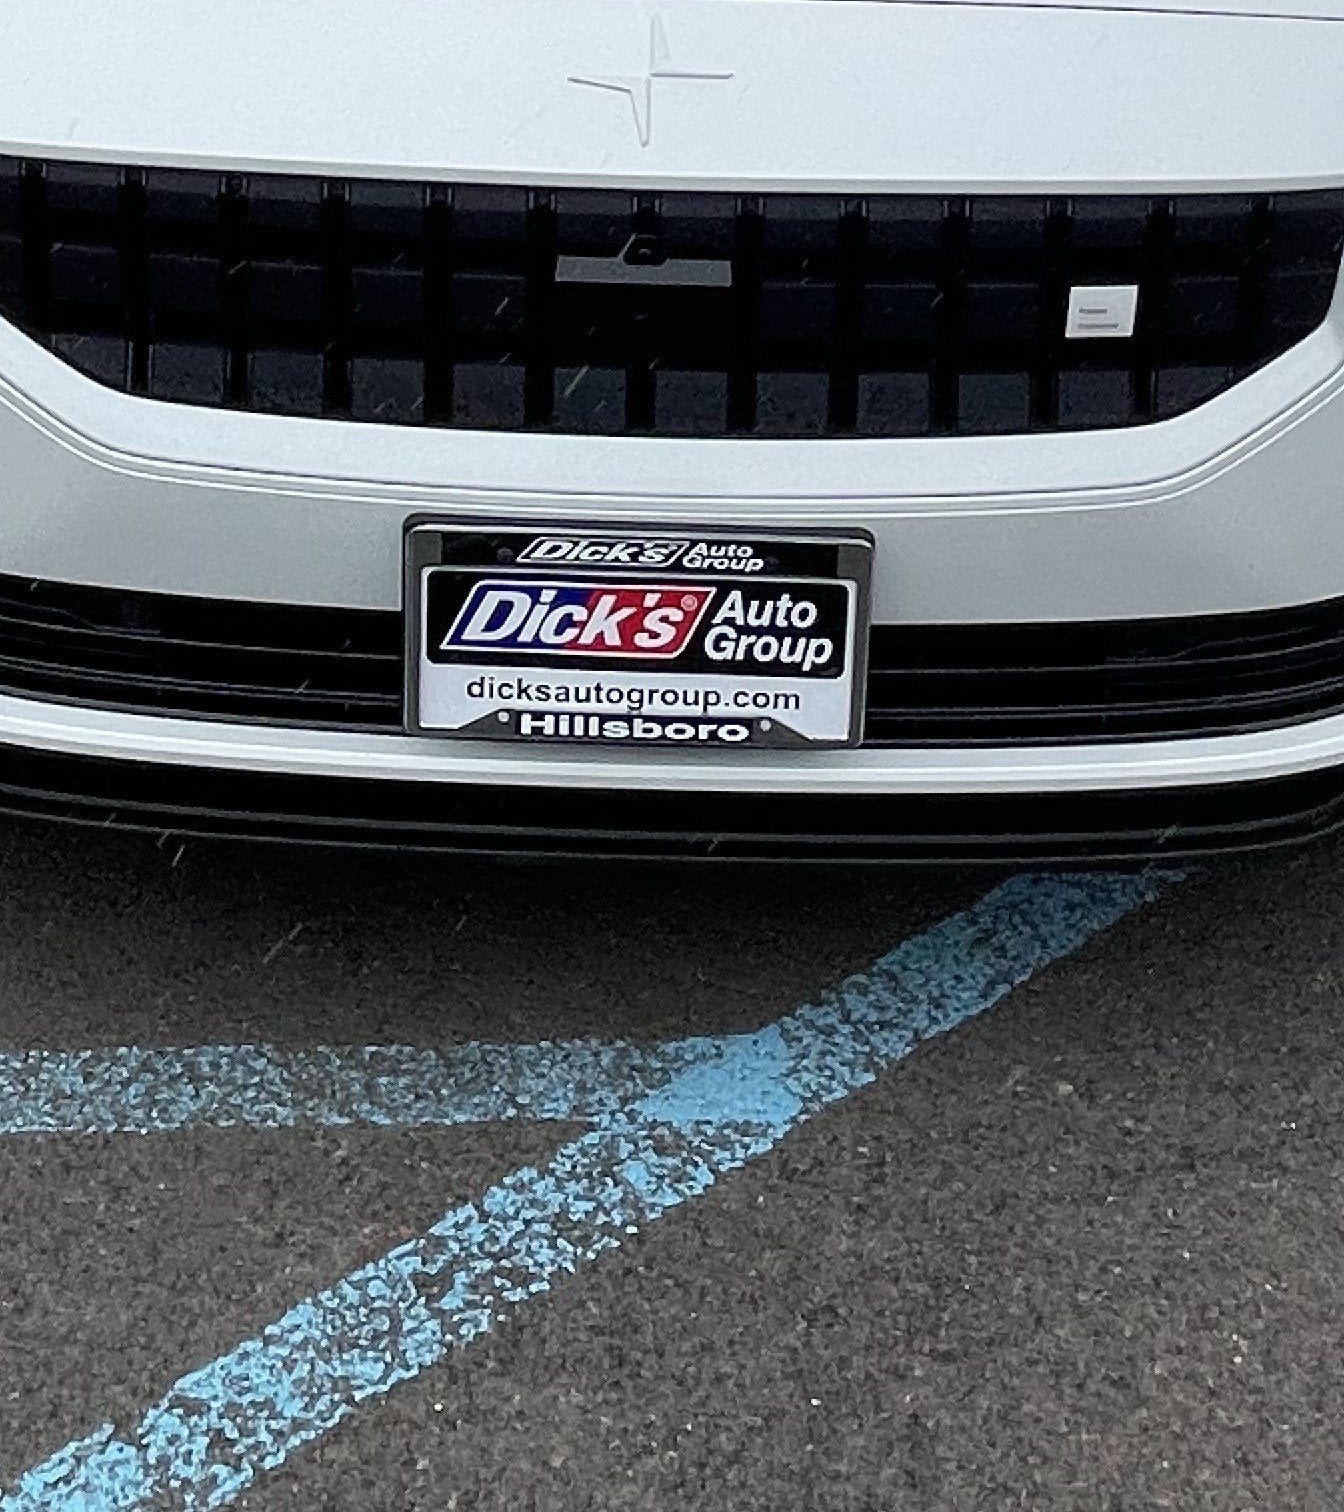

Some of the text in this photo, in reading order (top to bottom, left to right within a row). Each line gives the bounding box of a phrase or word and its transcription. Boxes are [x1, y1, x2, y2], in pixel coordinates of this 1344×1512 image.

[529, 537, 673, 564] Dick's
[681, 554, 765, 574] Group
[686, 541, 755, 560] Auto
[460, 588, 685, 649] Dick's
[711, 590, 818, 630] Auto
[703, 626, 834, 672] Group
[466, 675, 801, 714] dicksautogroup.com
[519, 712, 750, 742] Hillsboro
